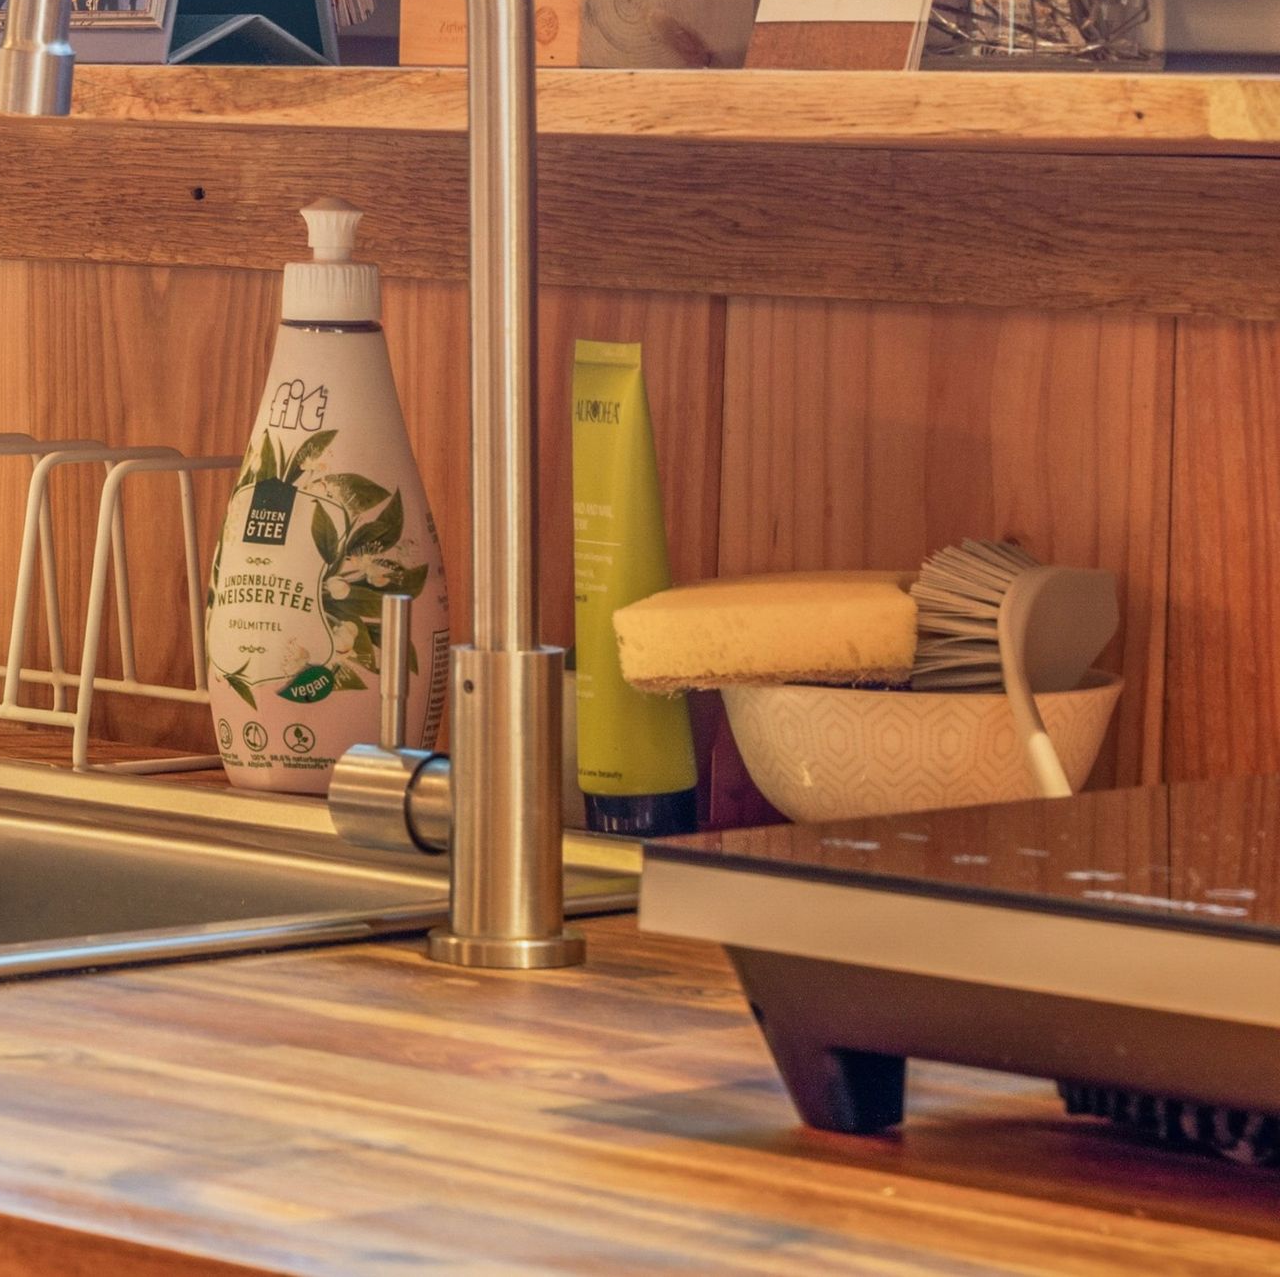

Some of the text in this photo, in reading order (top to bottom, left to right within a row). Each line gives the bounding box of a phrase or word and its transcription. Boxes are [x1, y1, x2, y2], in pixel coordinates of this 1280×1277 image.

[269, 378, 327, 432] fit
[250, 508, 286, 522] BLÜTEN
[225, 574, 305, 594] LINDENBLÜTE &
[218, 588, 315, 613] WEISSER TEE
[229, 618, 283, 632] SPÜLMITTEL
[290, 675, 330, 697] vegan
